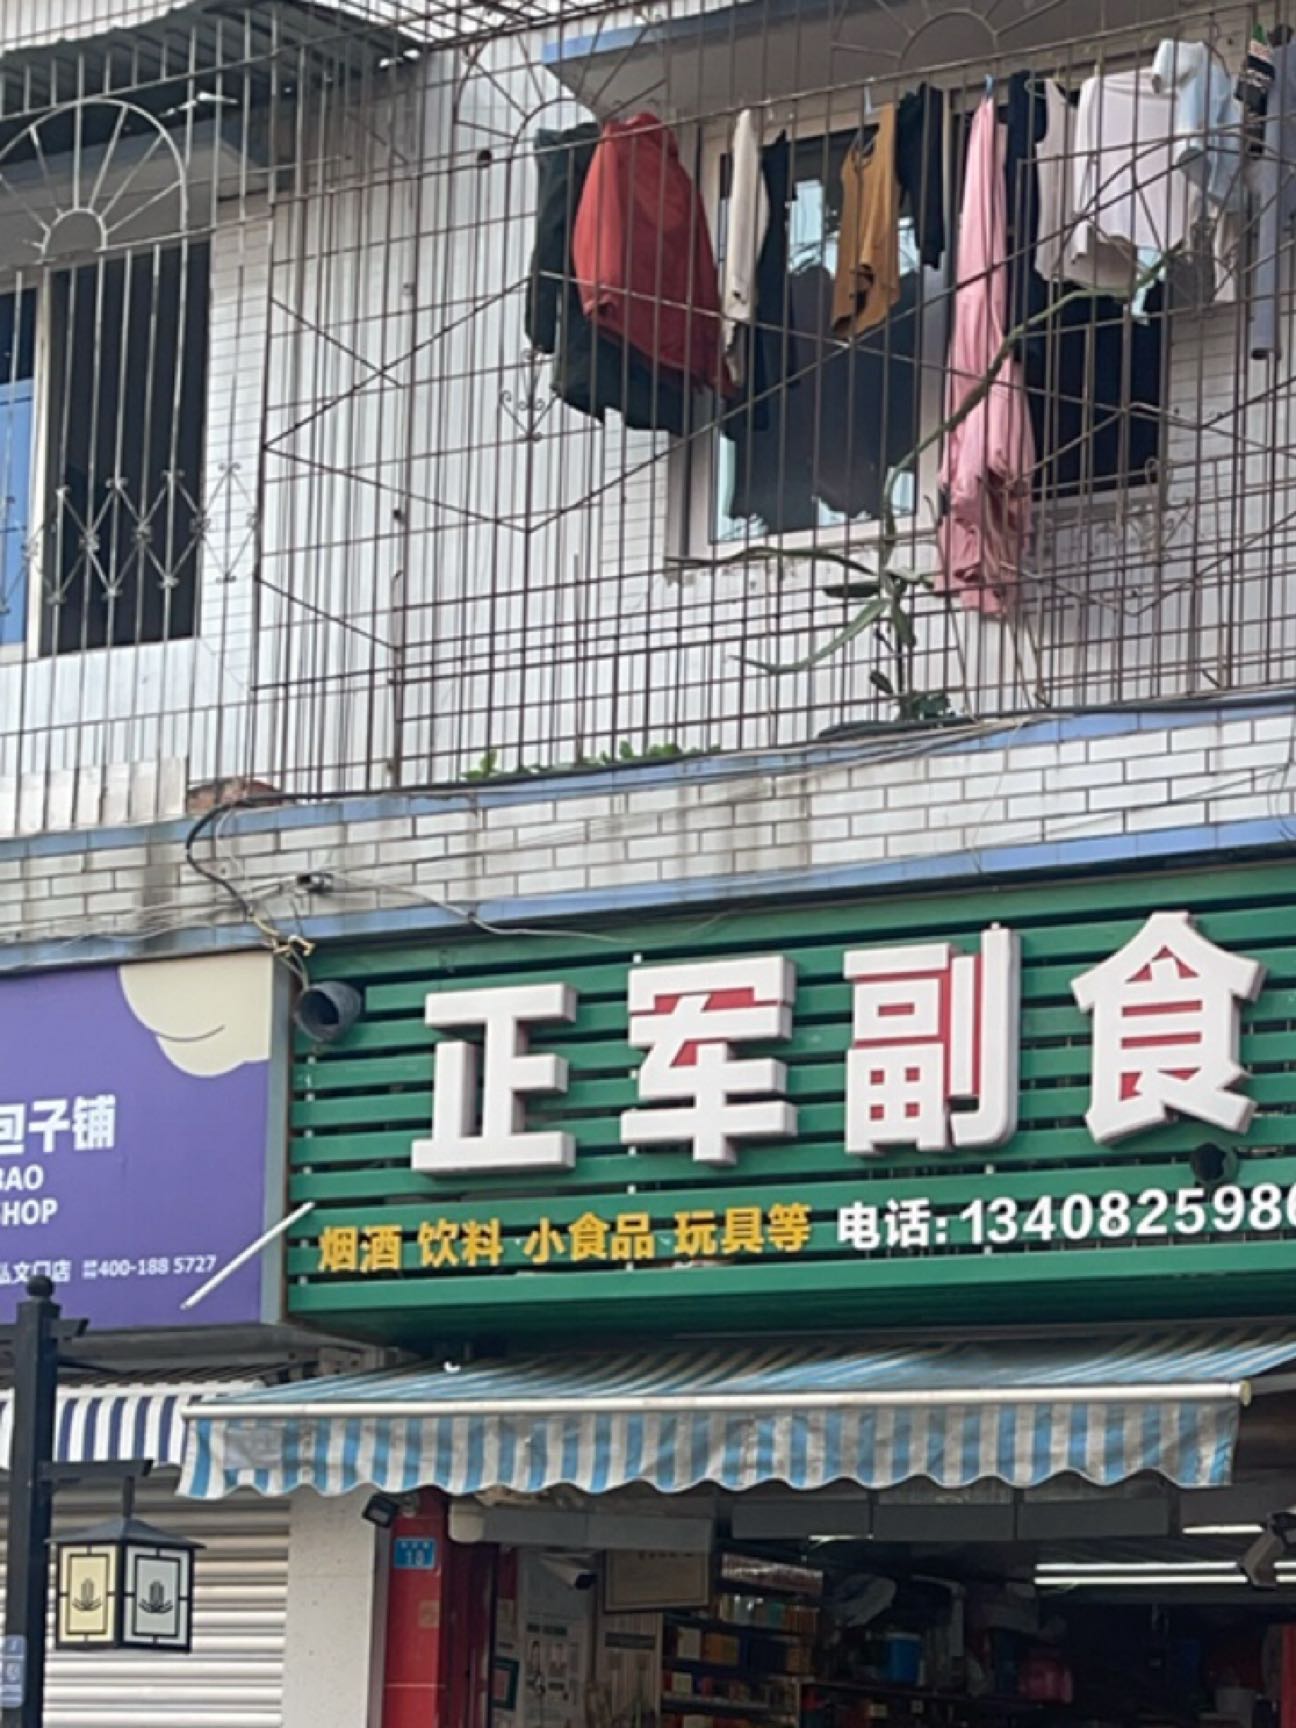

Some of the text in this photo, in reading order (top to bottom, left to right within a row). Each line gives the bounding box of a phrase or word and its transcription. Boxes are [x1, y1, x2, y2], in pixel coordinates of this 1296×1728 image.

[409, 911, 1268, 1178] 正军副食
[0, 1163, 45, 1192] AO
[317, 1203, 813, 1274] 烟酒 饮料 小食品 玩具等
